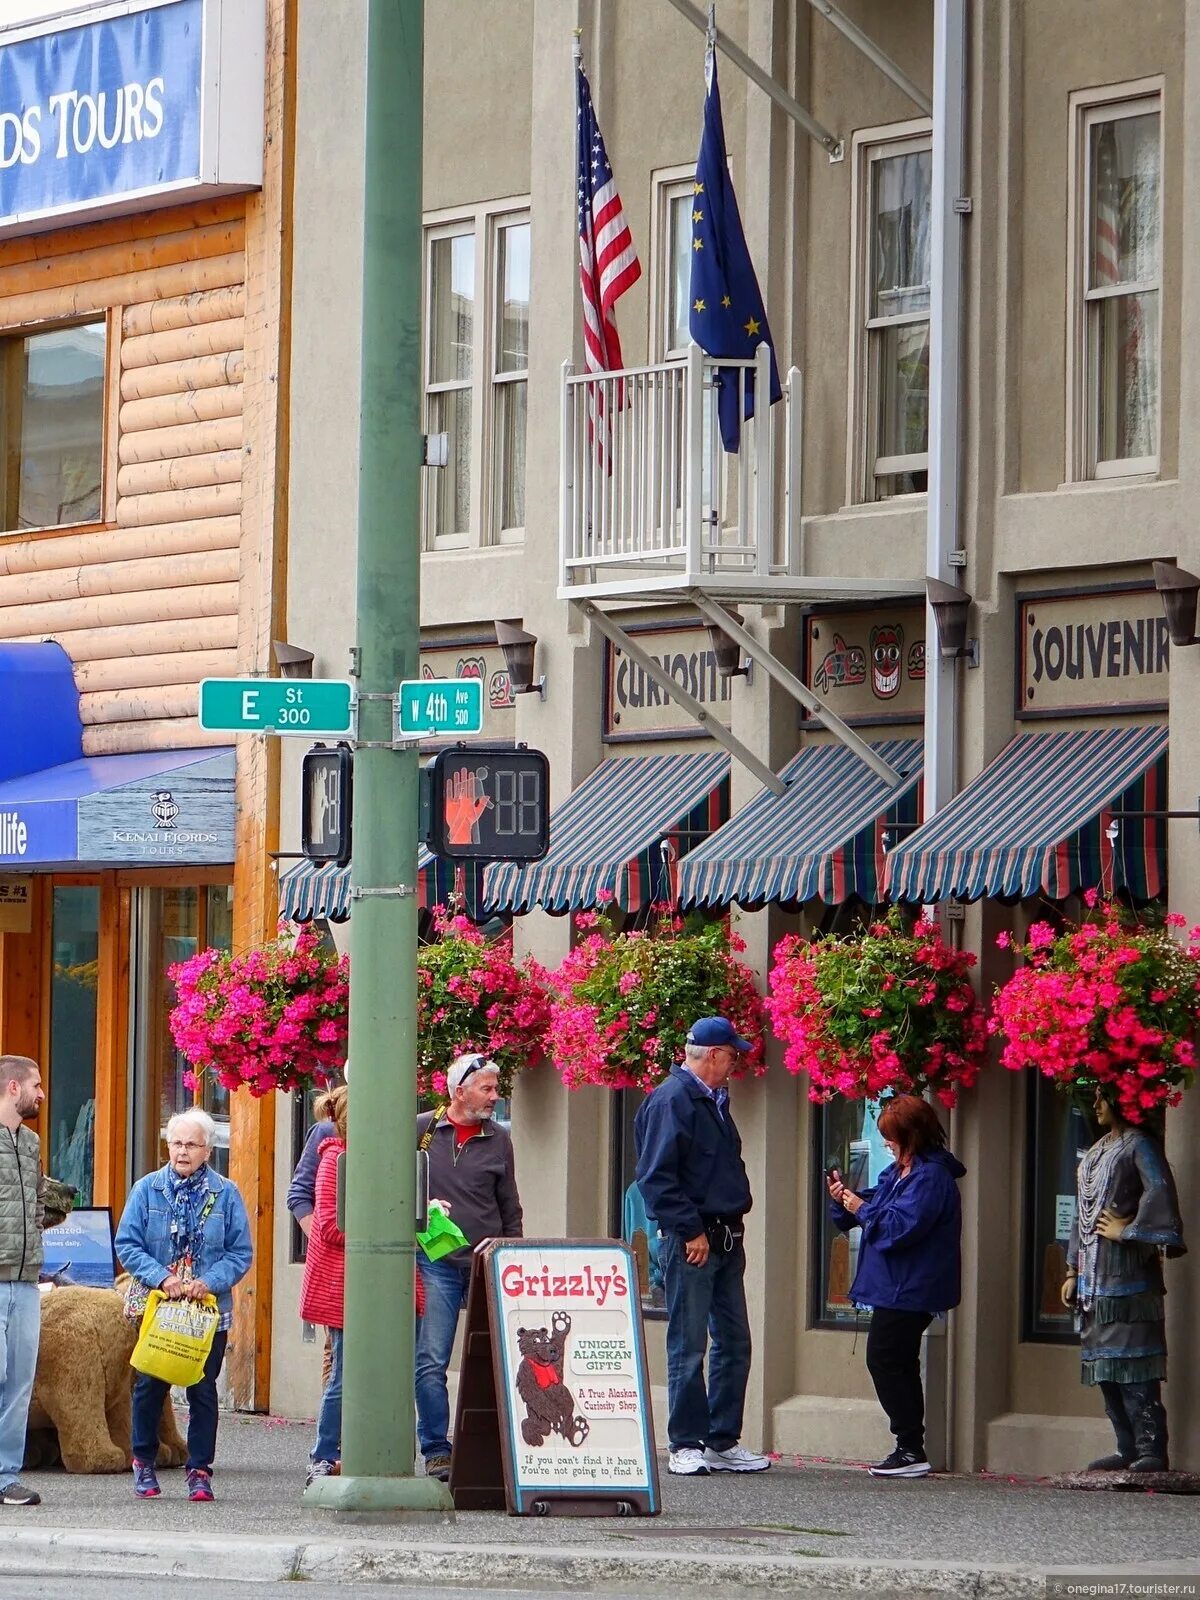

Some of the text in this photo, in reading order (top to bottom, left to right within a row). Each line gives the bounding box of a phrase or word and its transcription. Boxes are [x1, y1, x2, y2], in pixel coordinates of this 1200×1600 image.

[49, 77, 165, 159] TOURS
[241, 687, 303, 721] E St
[425, 692, 448, 722] 4th
[455, 688, 469, 705] Ave
[277, 708, 311, 725] 300
[455, 708, 469, 725] 500
[112, 832, 218, 845] KENAI FJORDS
[142, 846, 184, 855] TOURS
[13, 885, 28, 897] #1
[501, 1263, 628, 1306] Grizzly's
[578, 1340, 626, 1350] UNIQUE
[573, 1350, 632, 1360] ALASKAN
[586, 1361, 622, 1371] GIFTS
[578, 1388, 638, 1399] A True Alaskan
[584, 1400, 637, 1413] Curiosity Shop
[524, 1455, 638, 1466] If you can't find it here
[520, 1466, 550, 1475] You're
[554, 1467, 568, 1475] not
[572, 1467, 596, 1479] going
[613, 1466, 631, 1475] find
[636, 1467, 643, 1475] it
